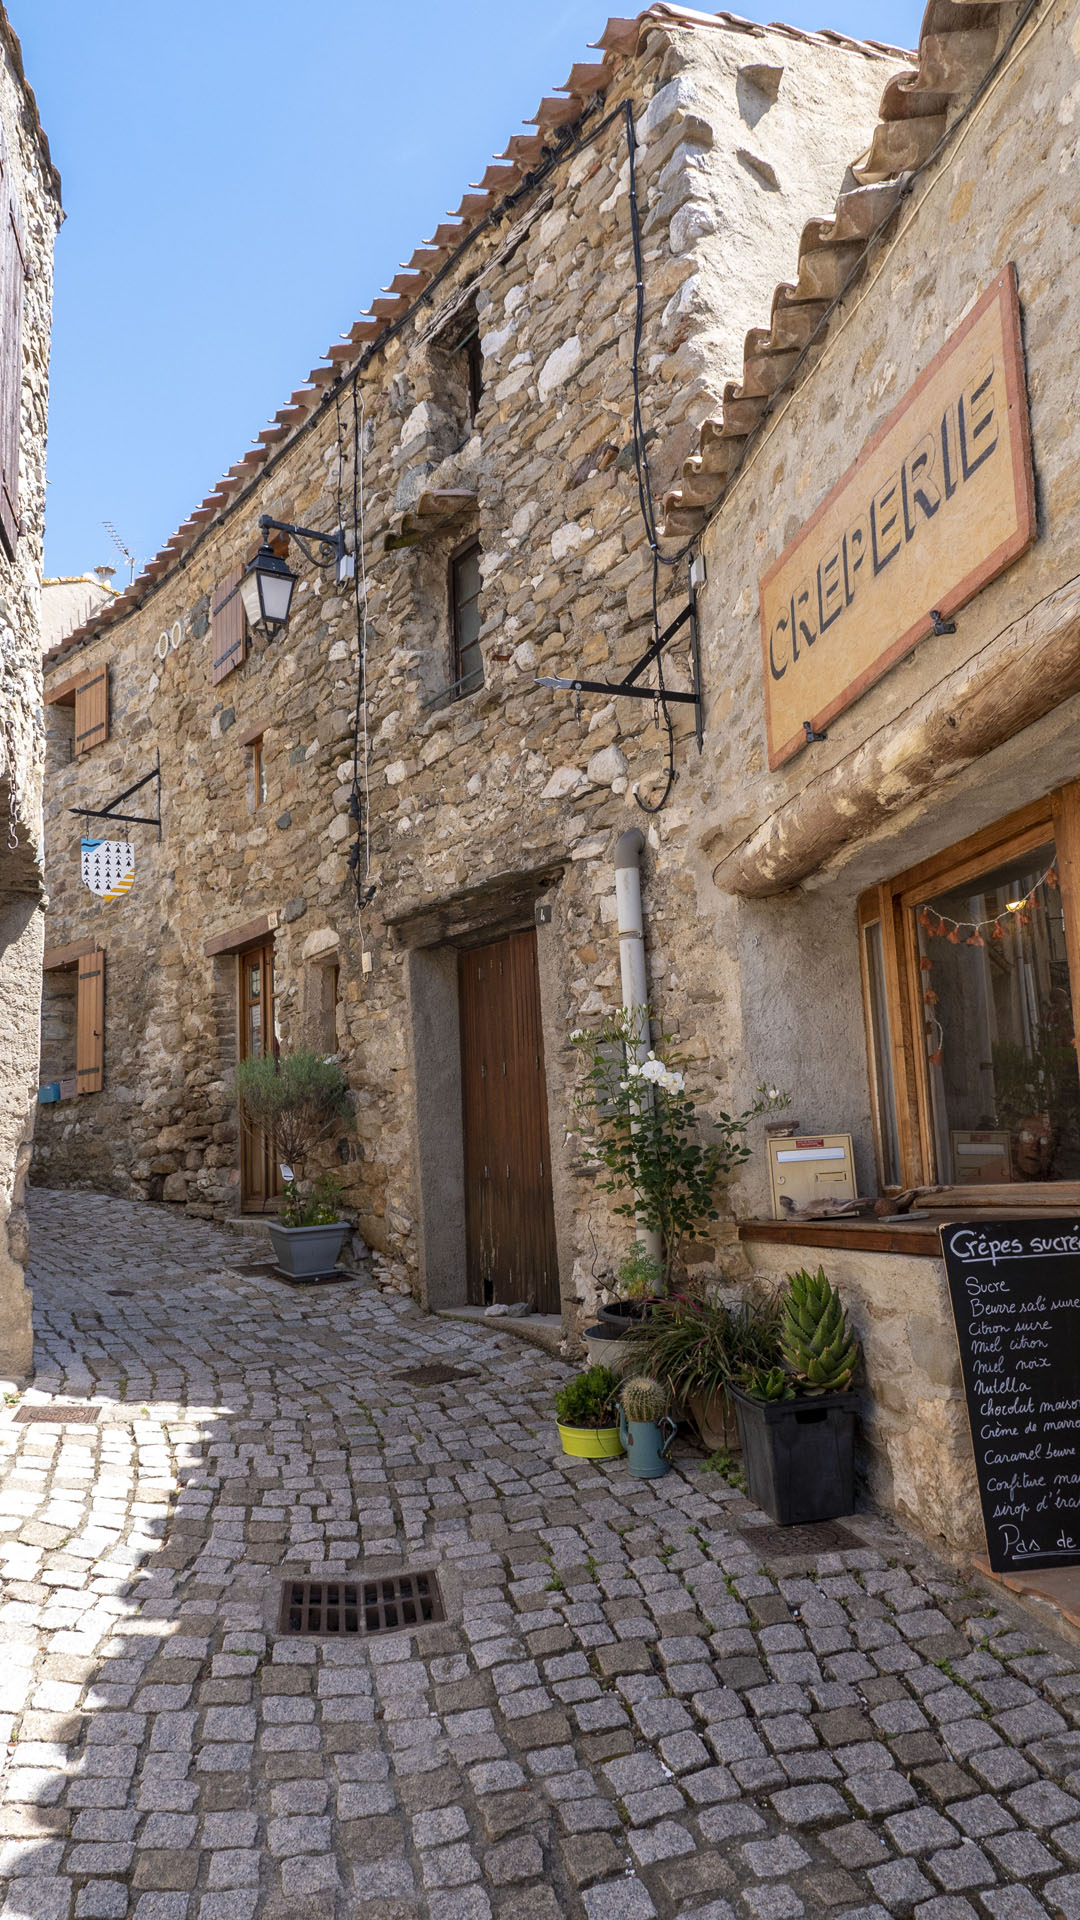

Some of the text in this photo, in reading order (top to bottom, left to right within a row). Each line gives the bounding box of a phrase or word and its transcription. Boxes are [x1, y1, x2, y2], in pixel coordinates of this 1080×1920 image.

[768, 357, 1000, 681] CREPERIE
[950, 1224, 1080, 1267] Crêpes sucré
[965, 1276, 1011, 1296] Sucre
[970, 1298, 1016, 1317] Beurre
[1019, 1295, 1047, 1313] salé
[968, 1320, 1011, 1336] Citron
[1009, 1335, 1048, 1350] citron
[1015, 1357, 1052, 1370] noix
[1039, 1396, 1080, 1413] maiso
[980, 1419, 1080, 1439] Crème de marro
[984, 1443, 1042, 1465] Caramel
[986, 1472, 1080, 1502] Confiture ma
[1036, 1489, 1080, 1512] d'éra
[998, 1523, 1077, 1556] Pas de
